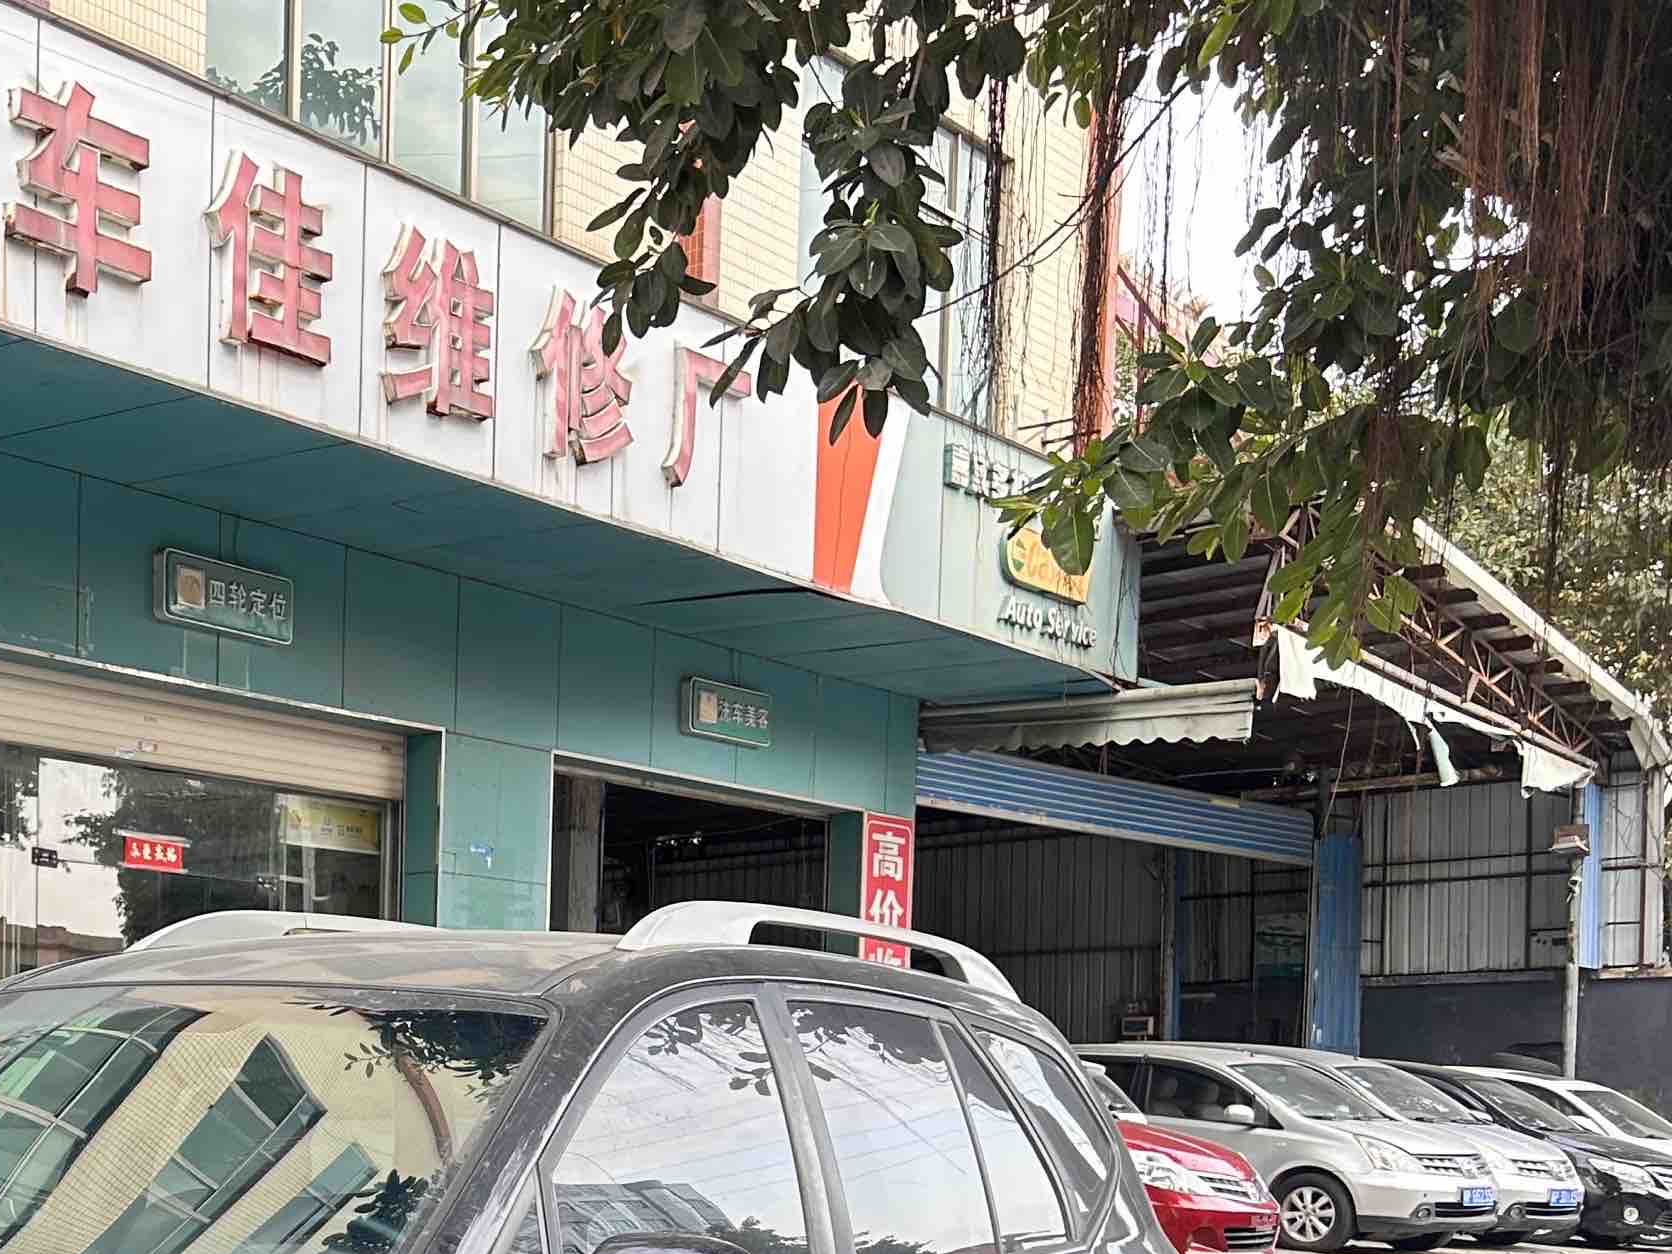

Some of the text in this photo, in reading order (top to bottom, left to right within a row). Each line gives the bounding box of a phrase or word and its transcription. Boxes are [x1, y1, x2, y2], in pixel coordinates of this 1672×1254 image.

[3, 81, 752, 488] 车佳维修厂
[208, 579, 288, 622] 四轮定位
[1002, 595, 1097, 648] Auto Service
